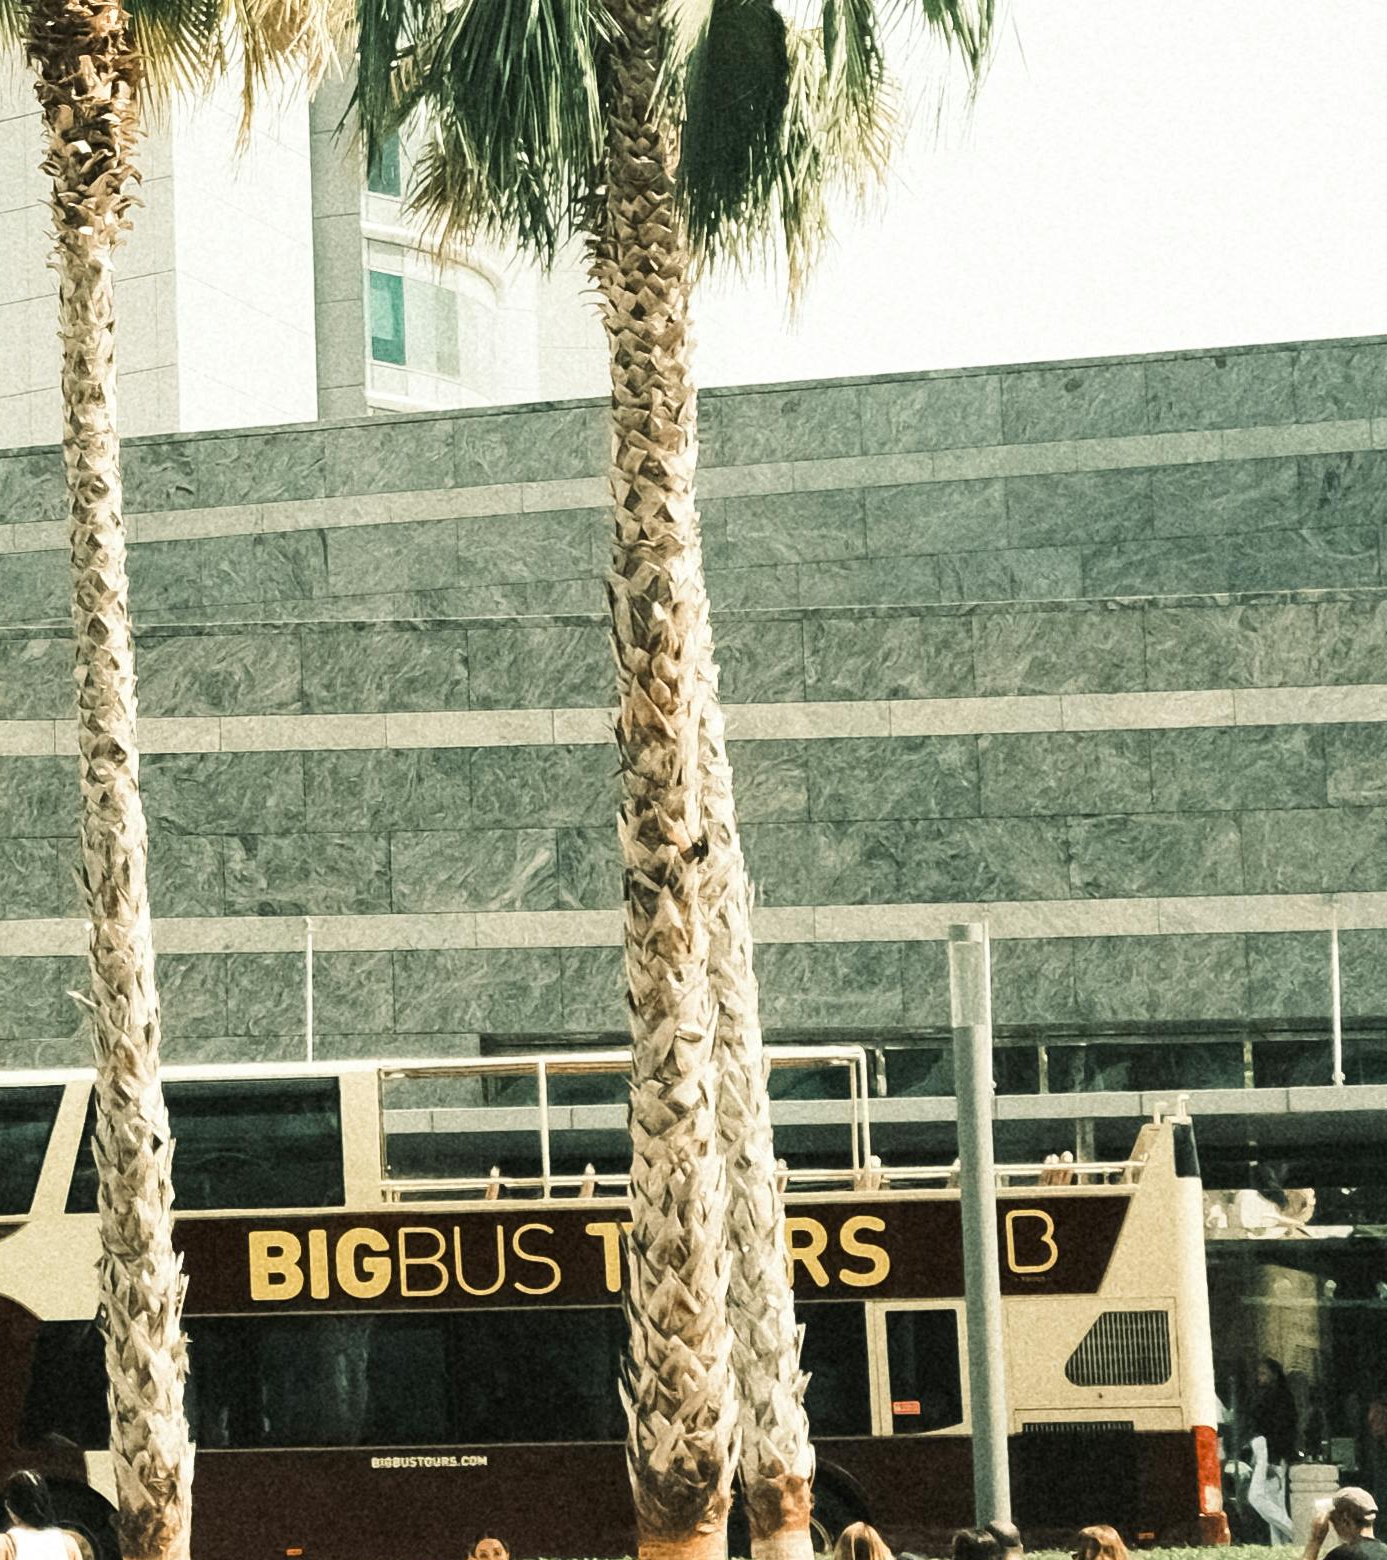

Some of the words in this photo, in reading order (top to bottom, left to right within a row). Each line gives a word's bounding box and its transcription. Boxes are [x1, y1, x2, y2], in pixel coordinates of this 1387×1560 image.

[585, 1215, 891, 1293] TRS
[1006, 1210, 1058, 1273] B
[371, 1456, 488, 1469] BIGBUSTOURS.COM
